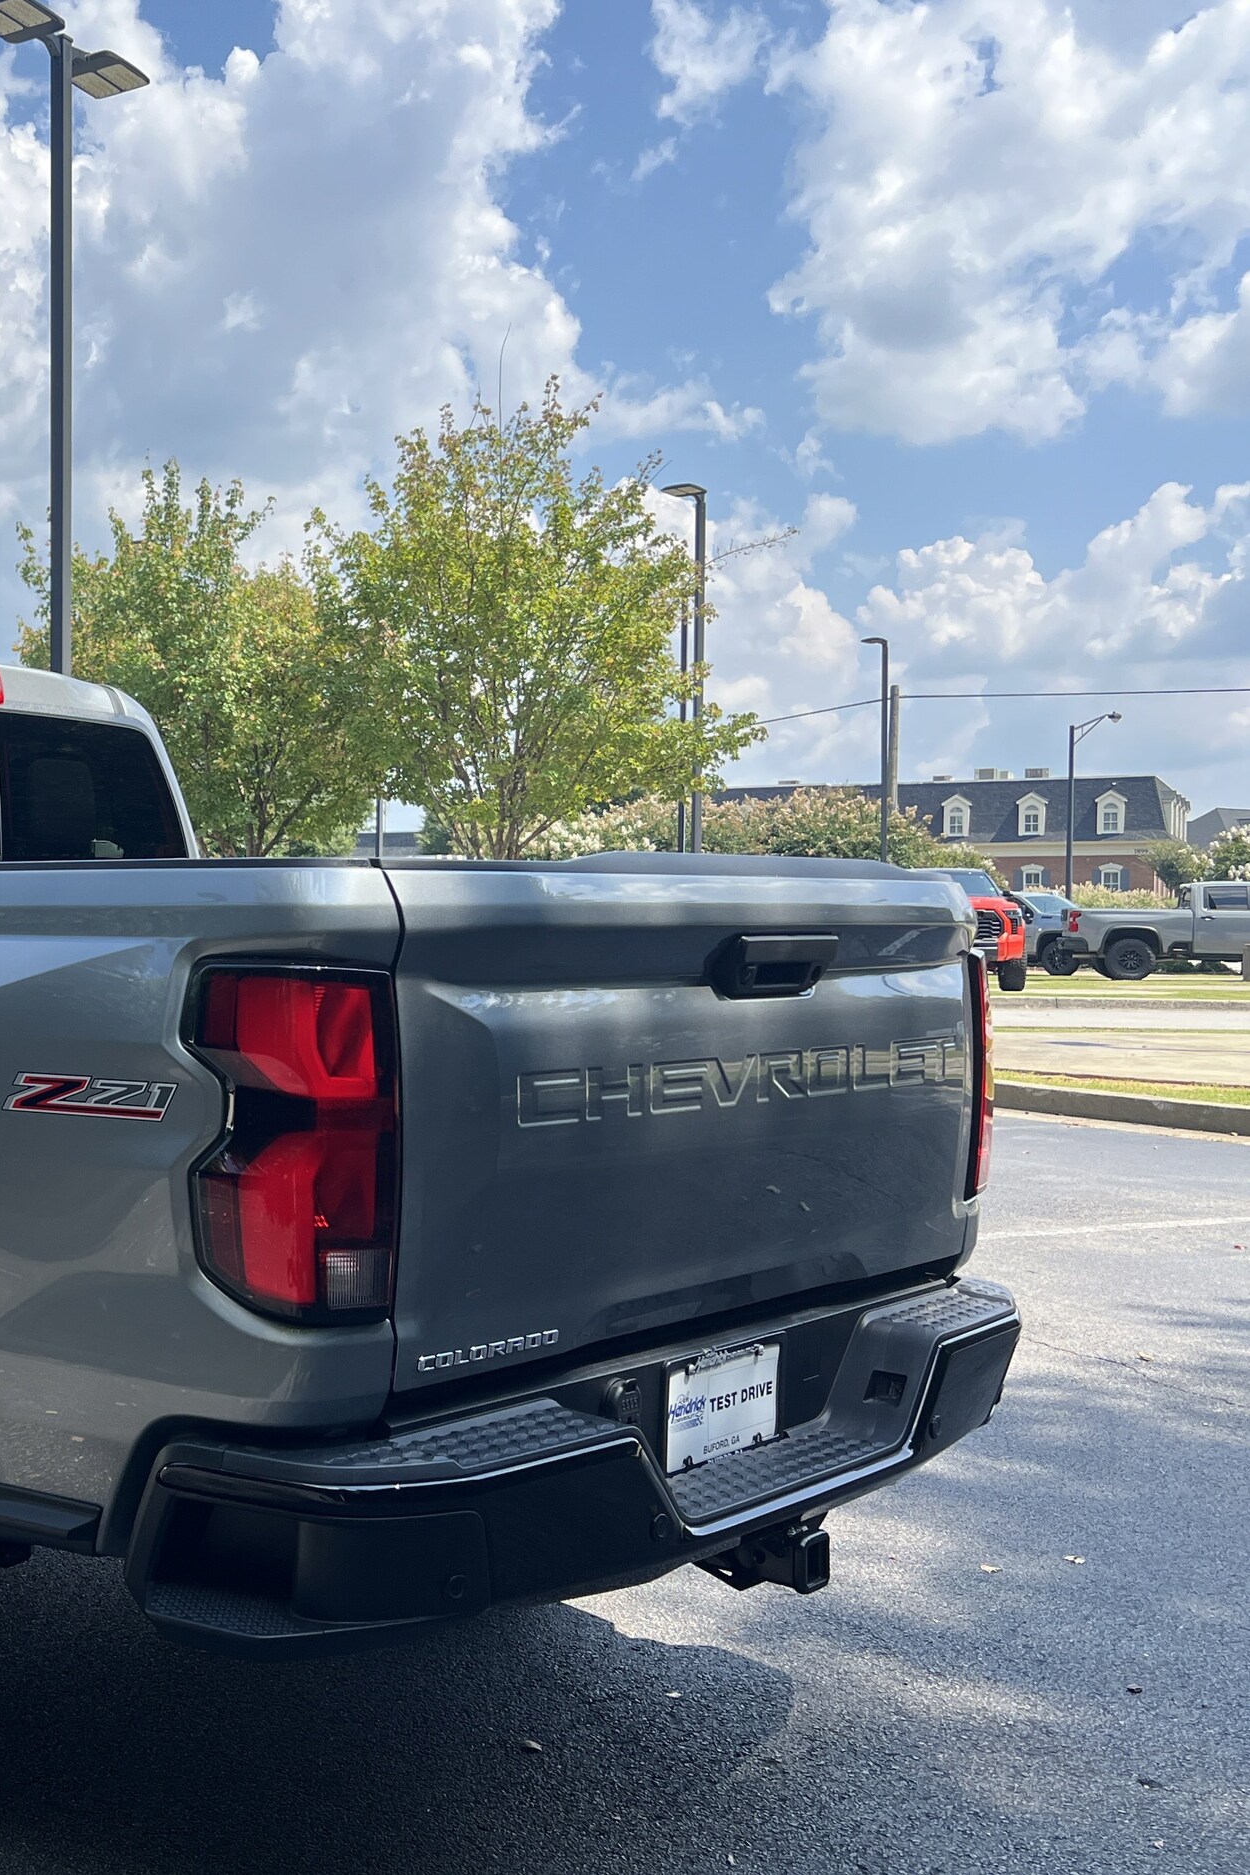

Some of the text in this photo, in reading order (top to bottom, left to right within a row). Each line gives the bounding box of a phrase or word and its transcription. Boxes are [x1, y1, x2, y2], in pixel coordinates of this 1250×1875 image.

[2, 1071, 179, 1122] Z71
[517, 1034, 957, 1127] CHEVROLET
[417, 1329, 560, 1372] COLORADO
[710, 1381, 773, 1412] TEST DRIVE
[731, 1435, 740, 1445] GA
